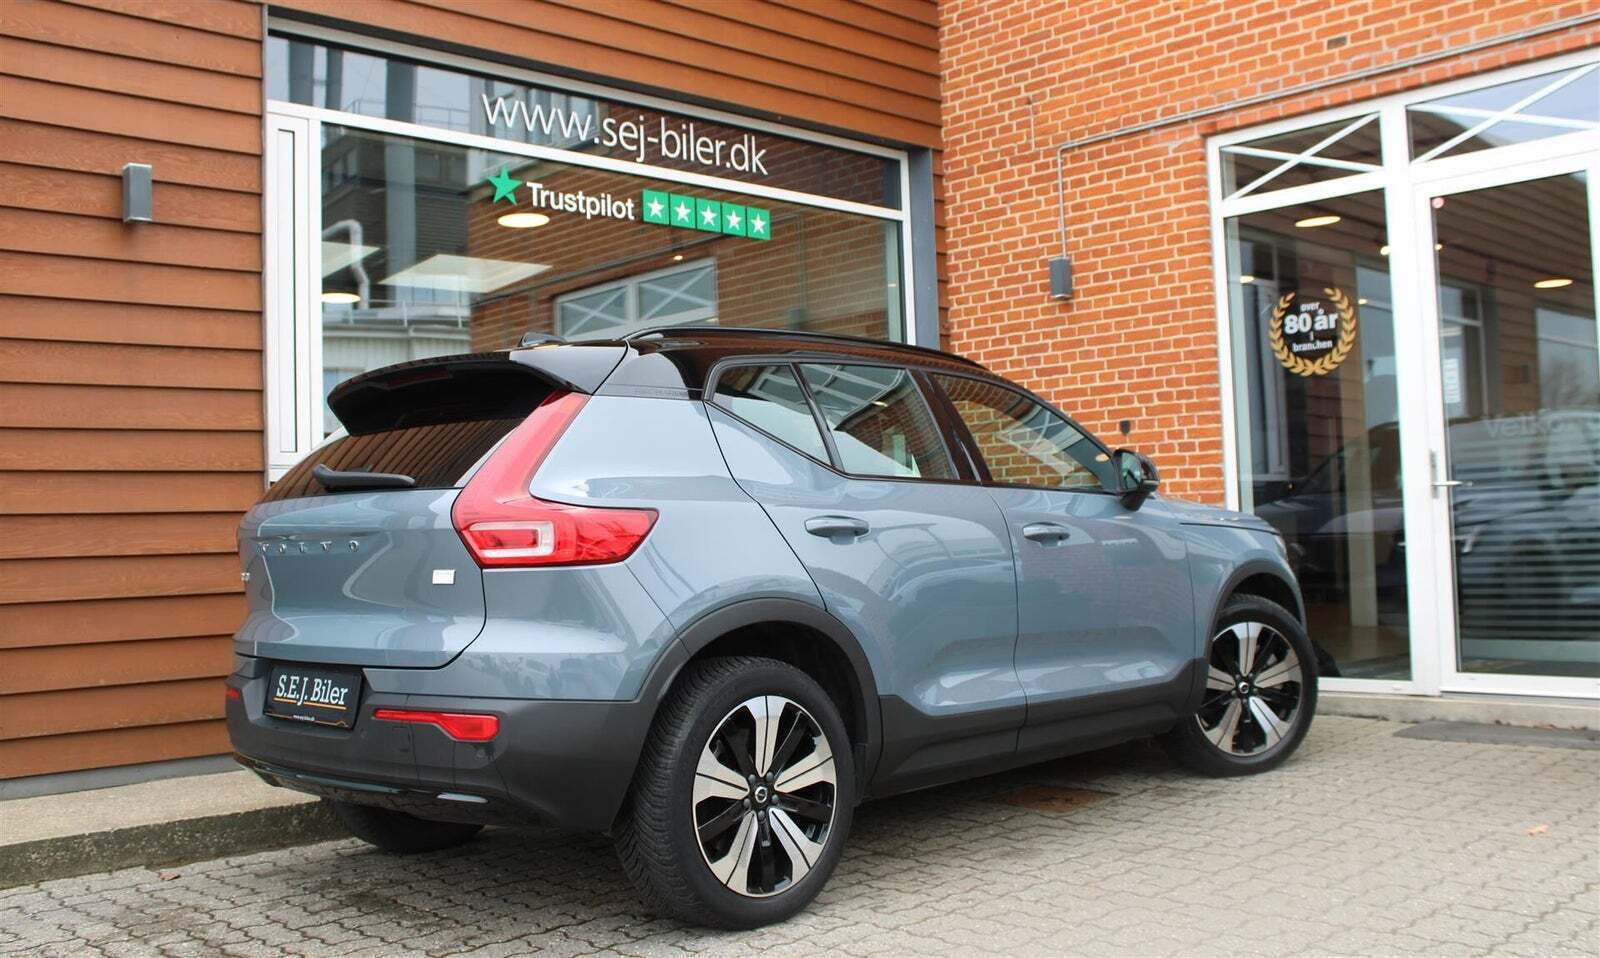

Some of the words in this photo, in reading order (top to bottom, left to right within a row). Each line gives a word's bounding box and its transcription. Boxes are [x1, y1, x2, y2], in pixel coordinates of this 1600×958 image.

[481, 93, 769, 176] www.sej-biler.dk
[526, 181, 636, 221] Trustpilot
[1300, 302, 1321, 312] over
[1284, 312, 1312, 335] 80
[1314, 308, 1339, 331] år
[1292, 340, 1333, 352] branchen
[257, 540, 361, 553] VOLVO
[275, 674, 309, 706] S.E.J.
[310, 678, 349, 705] Biler
